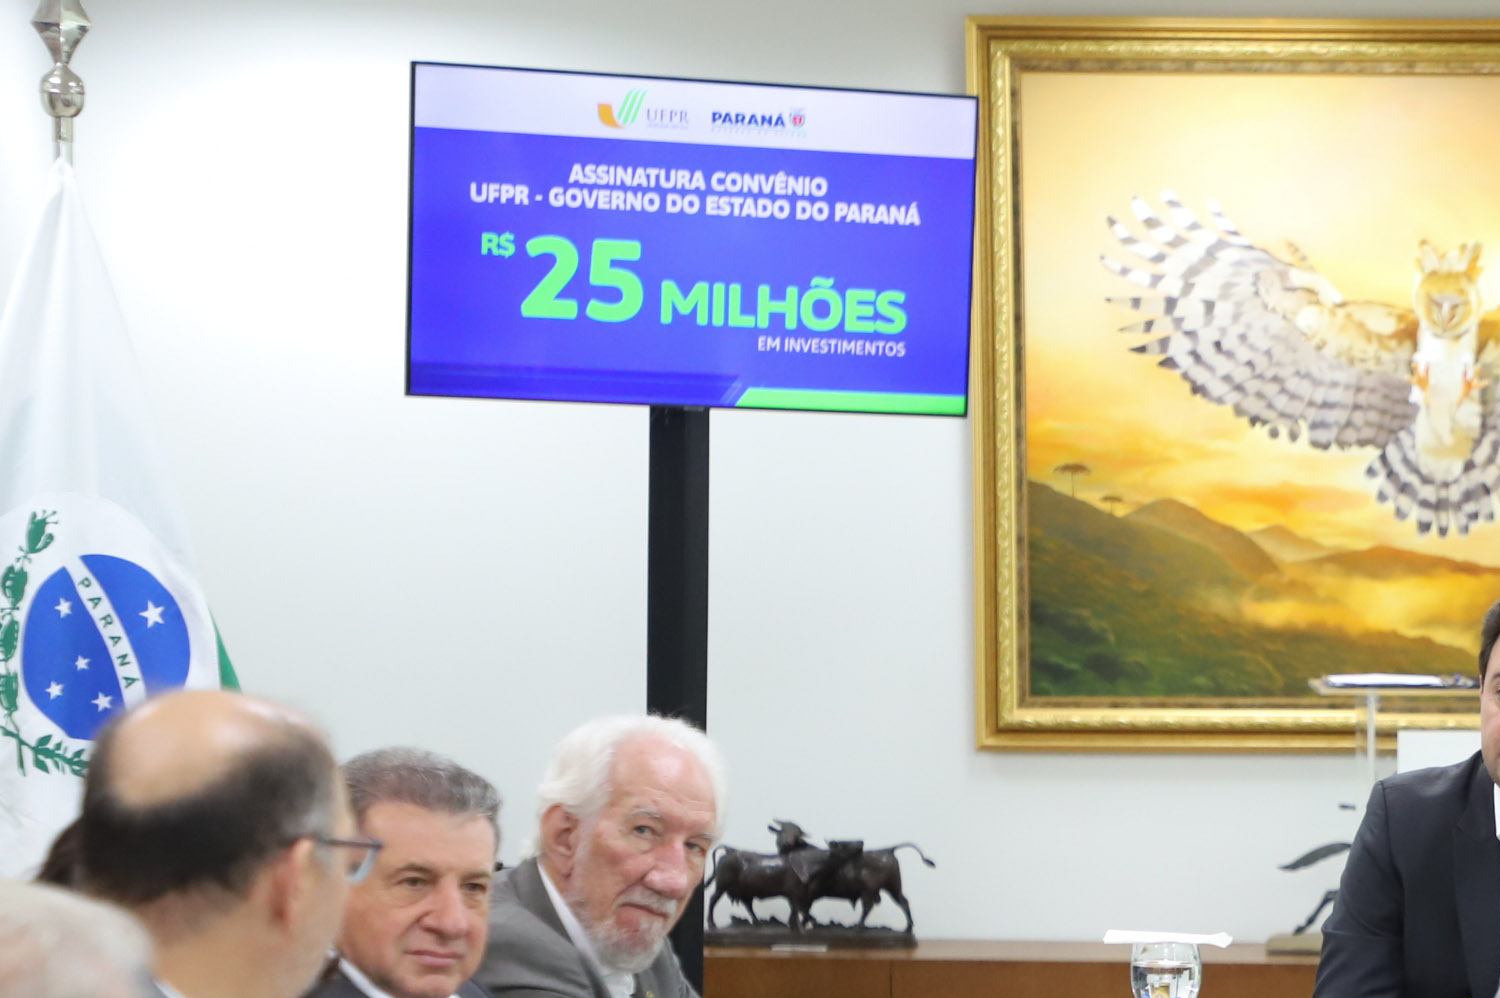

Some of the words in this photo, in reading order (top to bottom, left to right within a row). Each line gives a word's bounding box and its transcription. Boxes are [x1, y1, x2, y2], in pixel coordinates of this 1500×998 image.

[646, 108, 689, 123] UFPR
[711, 111, 786, 128] PARANÁ
[568, 163, 706, 191] ASSINATURA
[710, 171, 828, 197] CONVÊNIO
[470, 182, 529, 206] UFPR
[548, 187, 660, 213] GOVERNO
[665, 193, 700, 215] DO
[705, 196, 791, 220] ESTADO
[796, 199, 830, 222] DO
[834, 201, 921, 226] PARANÁ
[481, 231, 515, 259] R$
[520, 235, 644, 322] 25
[659, 276, 908, 335] MILHÕES
[757, 335, 780, 353] EM
[784, 337, 907, 357] INVESTIMENTOS
